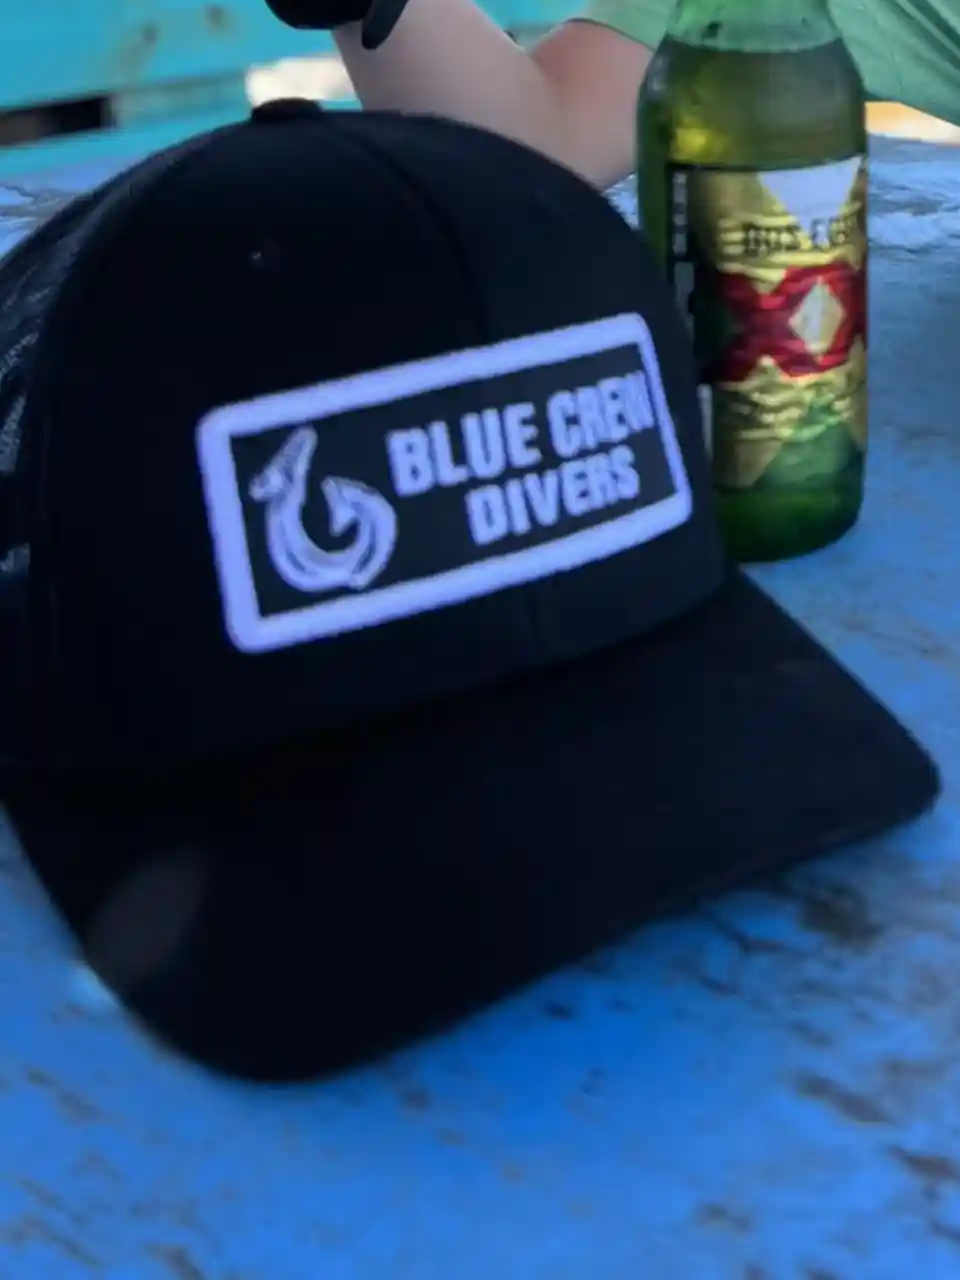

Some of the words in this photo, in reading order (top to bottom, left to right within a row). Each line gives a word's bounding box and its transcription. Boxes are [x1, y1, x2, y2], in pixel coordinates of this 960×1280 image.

[385, 402, 542, 498] BLUE
[546, 370, 656, 459] CREW
[465, 445, 641, 546] DIVERS
